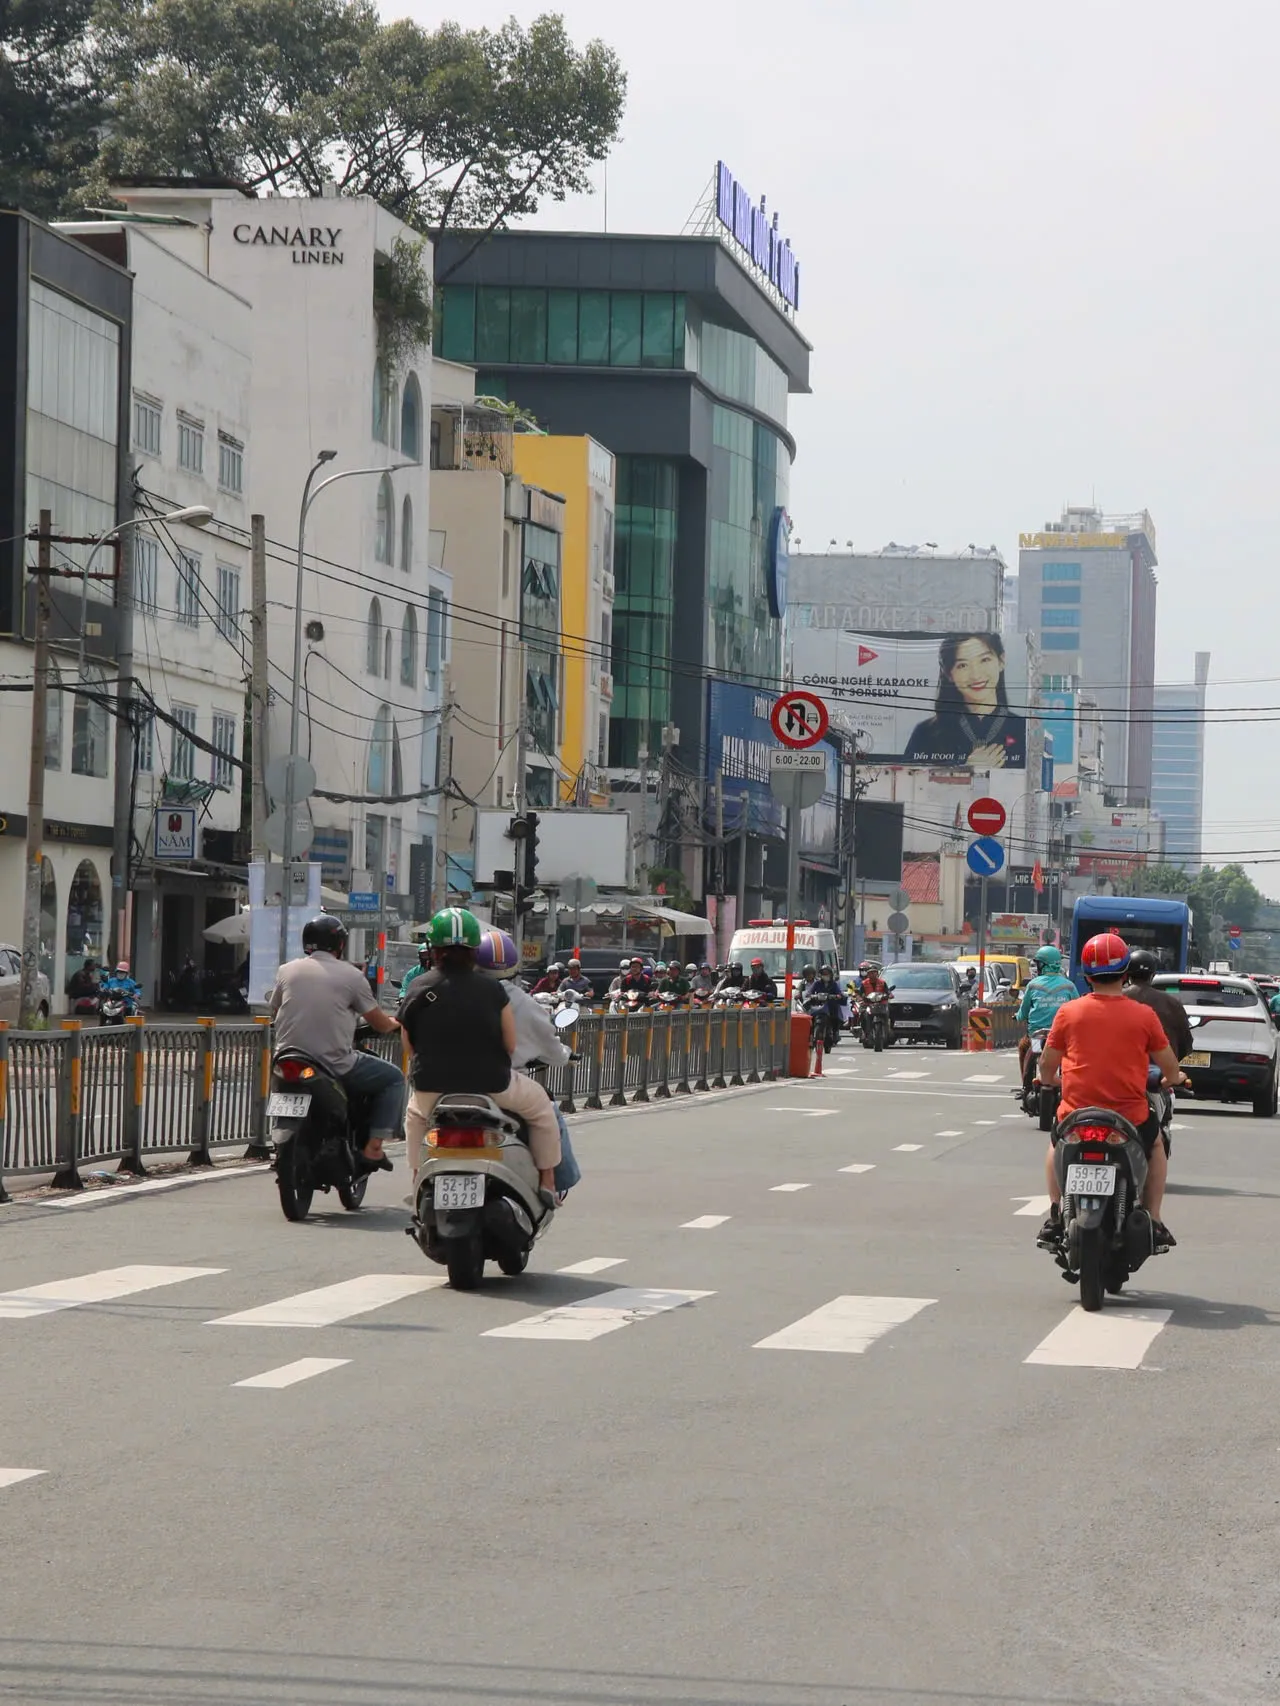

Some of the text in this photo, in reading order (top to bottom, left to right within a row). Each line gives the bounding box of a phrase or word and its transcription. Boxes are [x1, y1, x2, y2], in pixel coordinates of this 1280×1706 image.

[233, 224, 342, 247] CANARY
[292, 251, 343, 264] LINEN
[802, 674, 837, 685] CÔNG
[877, 678, 929, 687] KARAOKE
[1075, 1168, 1108, 1180] 59-F2
[442, 1178, 477, 1191] 52-P5
[1071, 1180, 1110, 1192] 330.07
[442, 1193, 477, 1206] 9328
